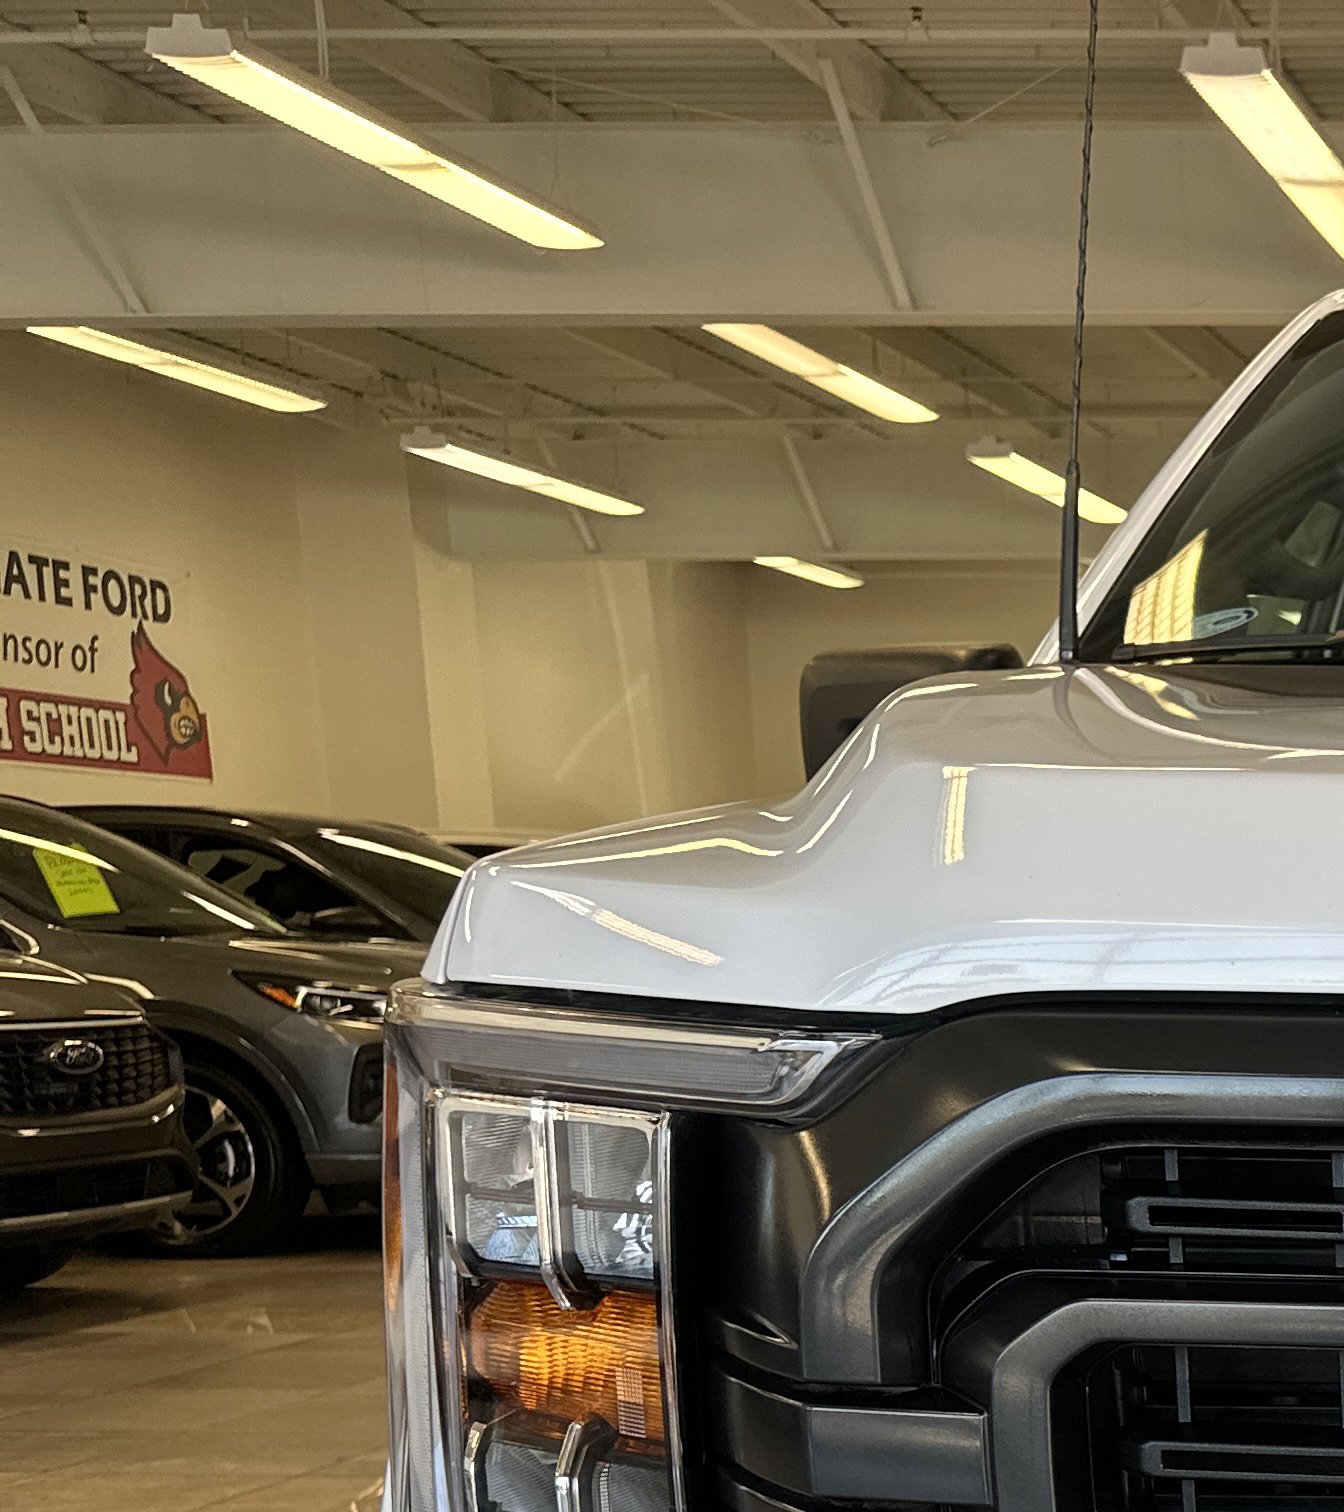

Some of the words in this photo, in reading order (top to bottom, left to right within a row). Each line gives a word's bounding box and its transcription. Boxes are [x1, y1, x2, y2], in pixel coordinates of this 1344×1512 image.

[0, 550, 73, 607] ATE
[81, 564, 172, 624] FORD
[3, 632, 64, 668] nsor
[71, 634, 99, 674] of
[19, 698, 139, 764] SCHOOL
